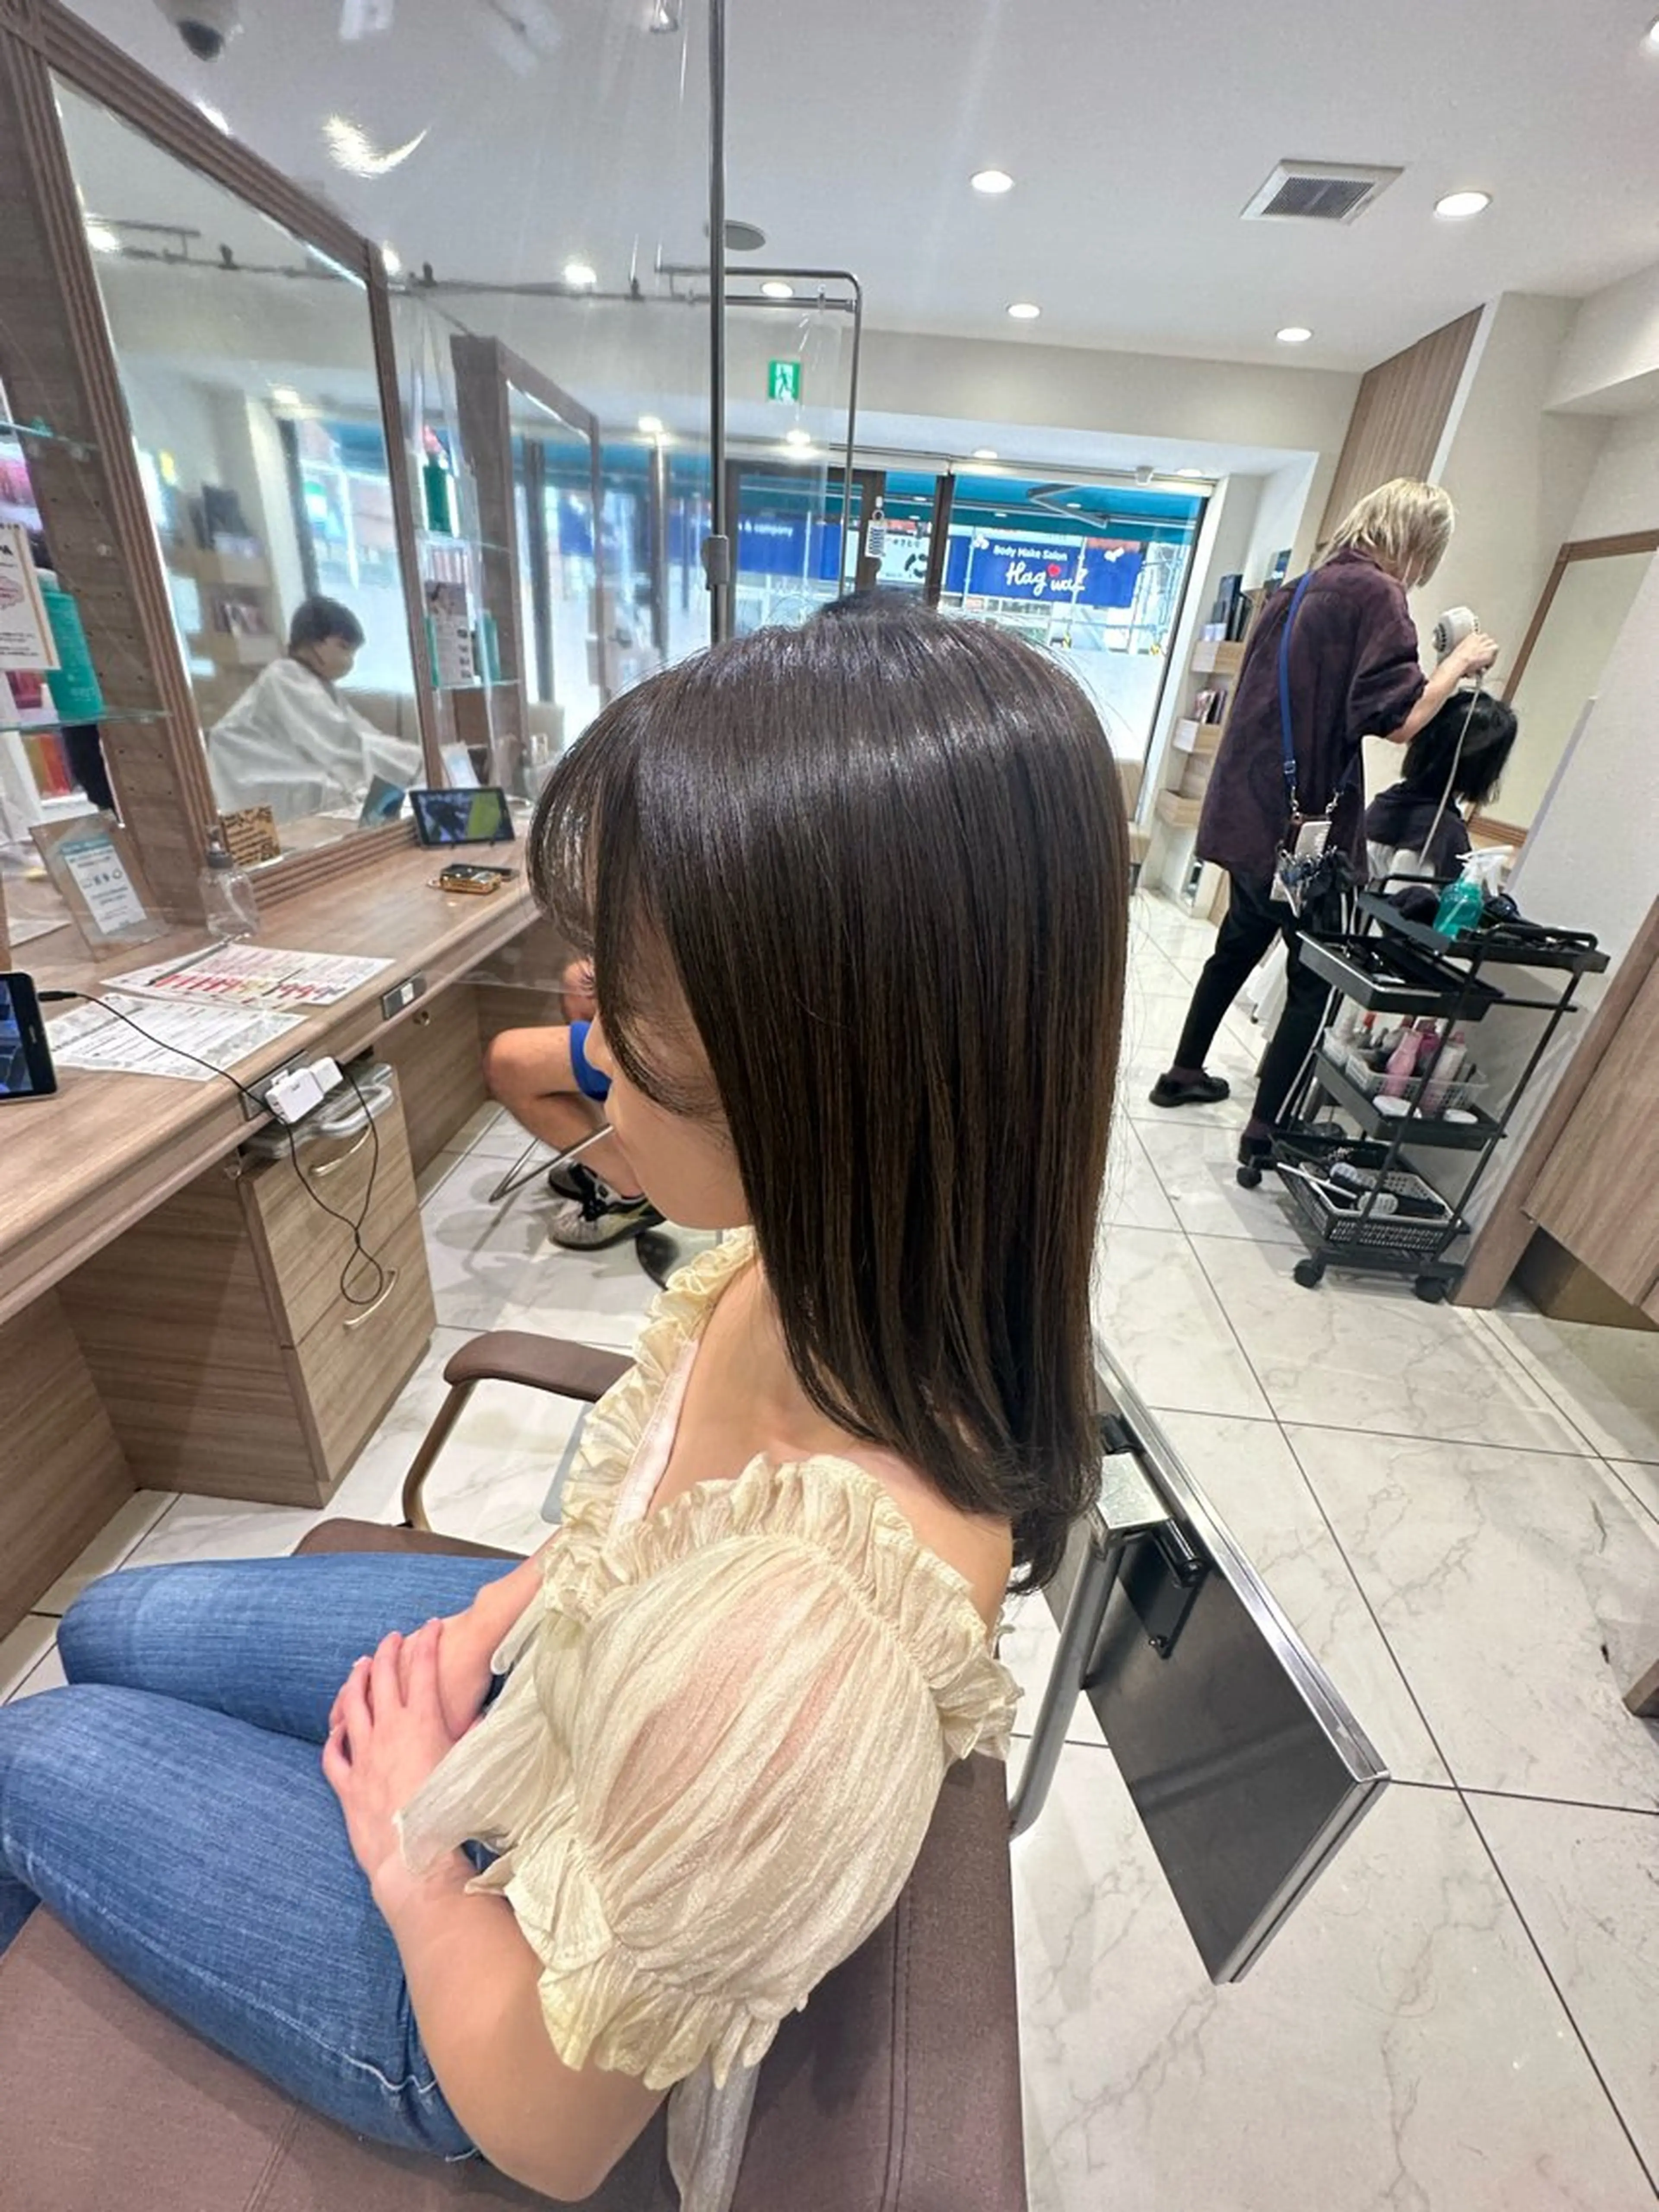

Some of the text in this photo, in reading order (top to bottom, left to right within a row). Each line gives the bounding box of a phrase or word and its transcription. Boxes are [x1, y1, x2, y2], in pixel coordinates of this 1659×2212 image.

[994, 545, 1068, 561] Body Make Salon
